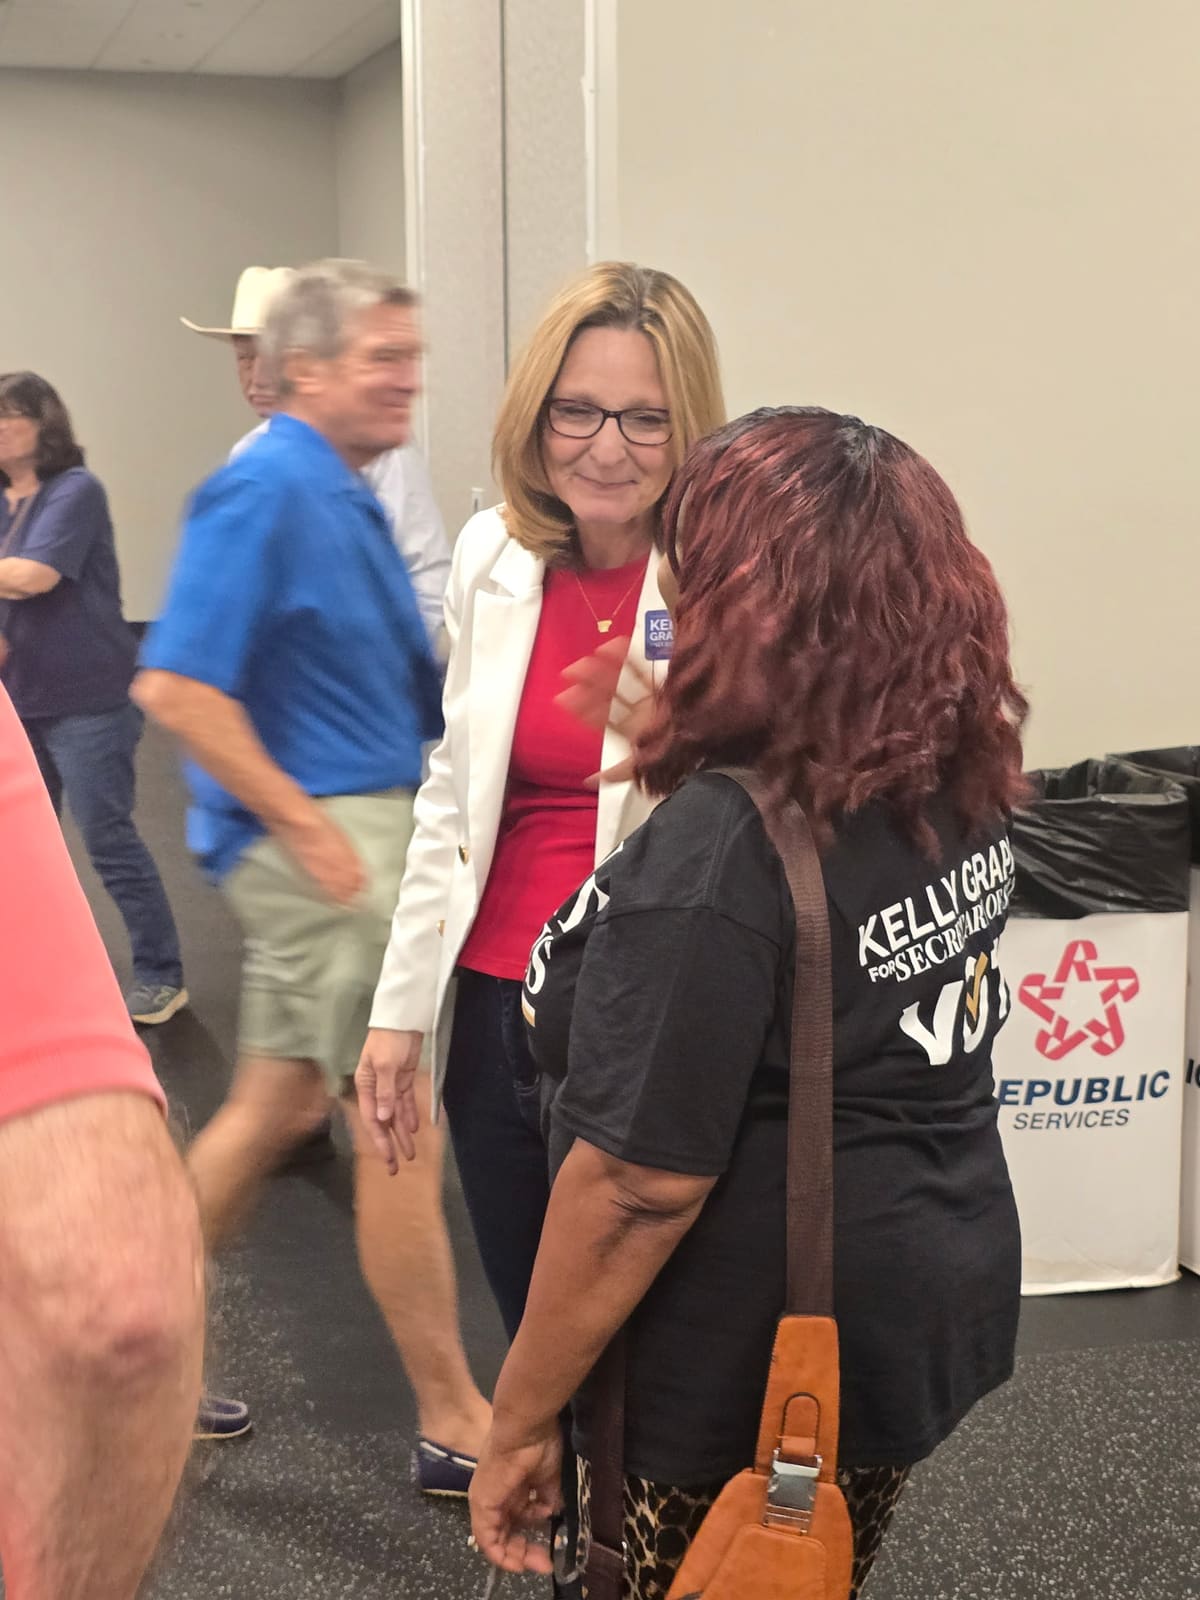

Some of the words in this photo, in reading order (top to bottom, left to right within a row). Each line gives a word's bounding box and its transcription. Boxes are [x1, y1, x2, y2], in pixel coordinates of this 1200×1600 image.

[858, 869, 959, 967] KELLY
[868, 959, 896, 983] FOR
[998, 1069, 1170, 1106] EPUBLIC
[1012, 1108, 1131, 1130] SERVICES
